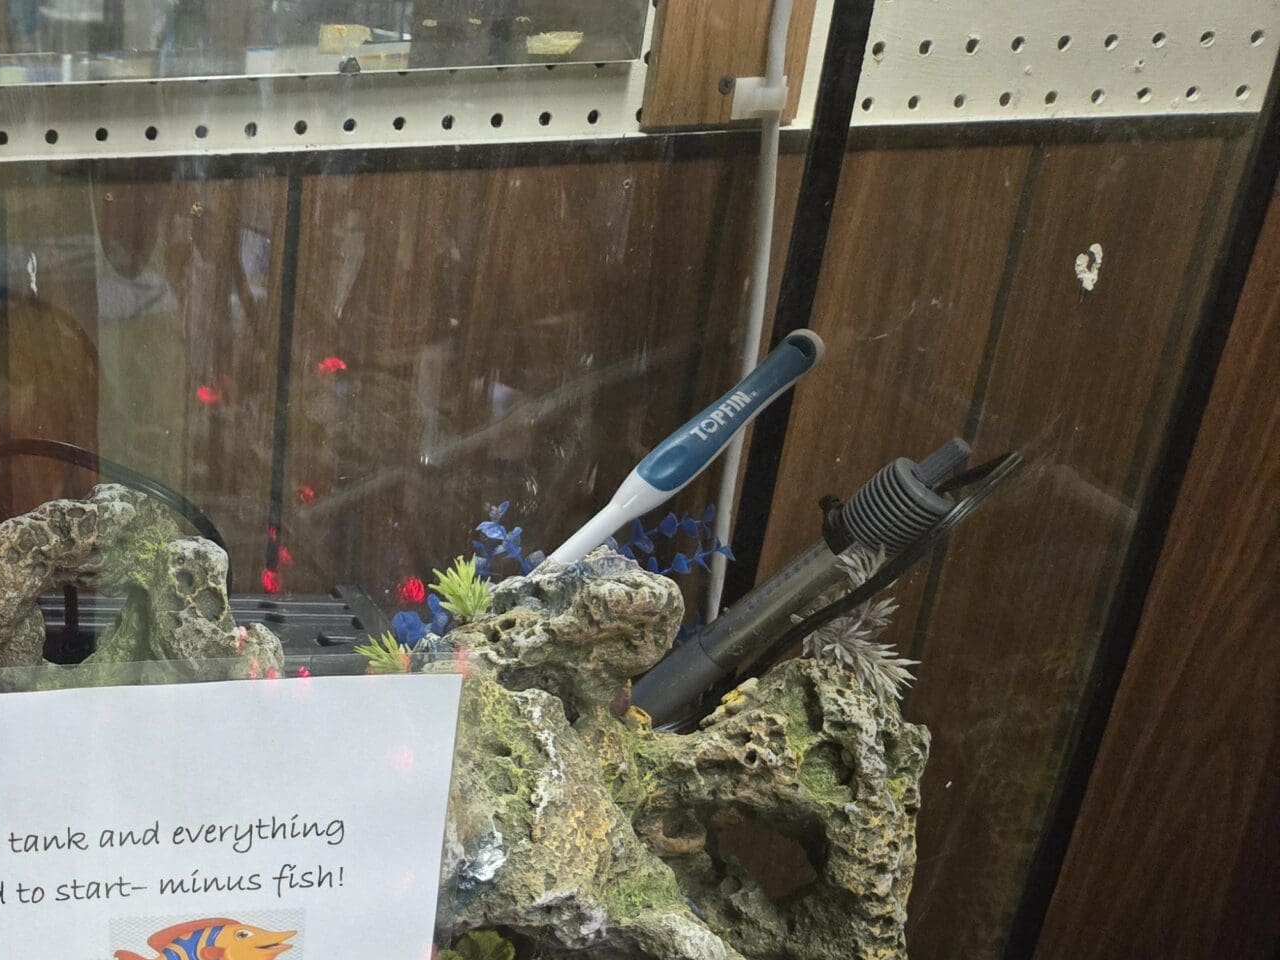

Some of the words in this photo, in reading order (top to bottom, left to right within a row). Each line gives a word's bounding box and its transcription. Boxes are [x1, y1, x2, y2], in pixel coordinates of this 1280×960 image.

[690, 391, 752, 441] TOPFIN
[8, 826, 90, 853] tank
[99, 821, 160, 848] and
[172, 814, 346, 853] everything
[16, 880, 46, 904] to
[160, 868, 262, 895] minus
[272, 864, 346, 898] fish!
